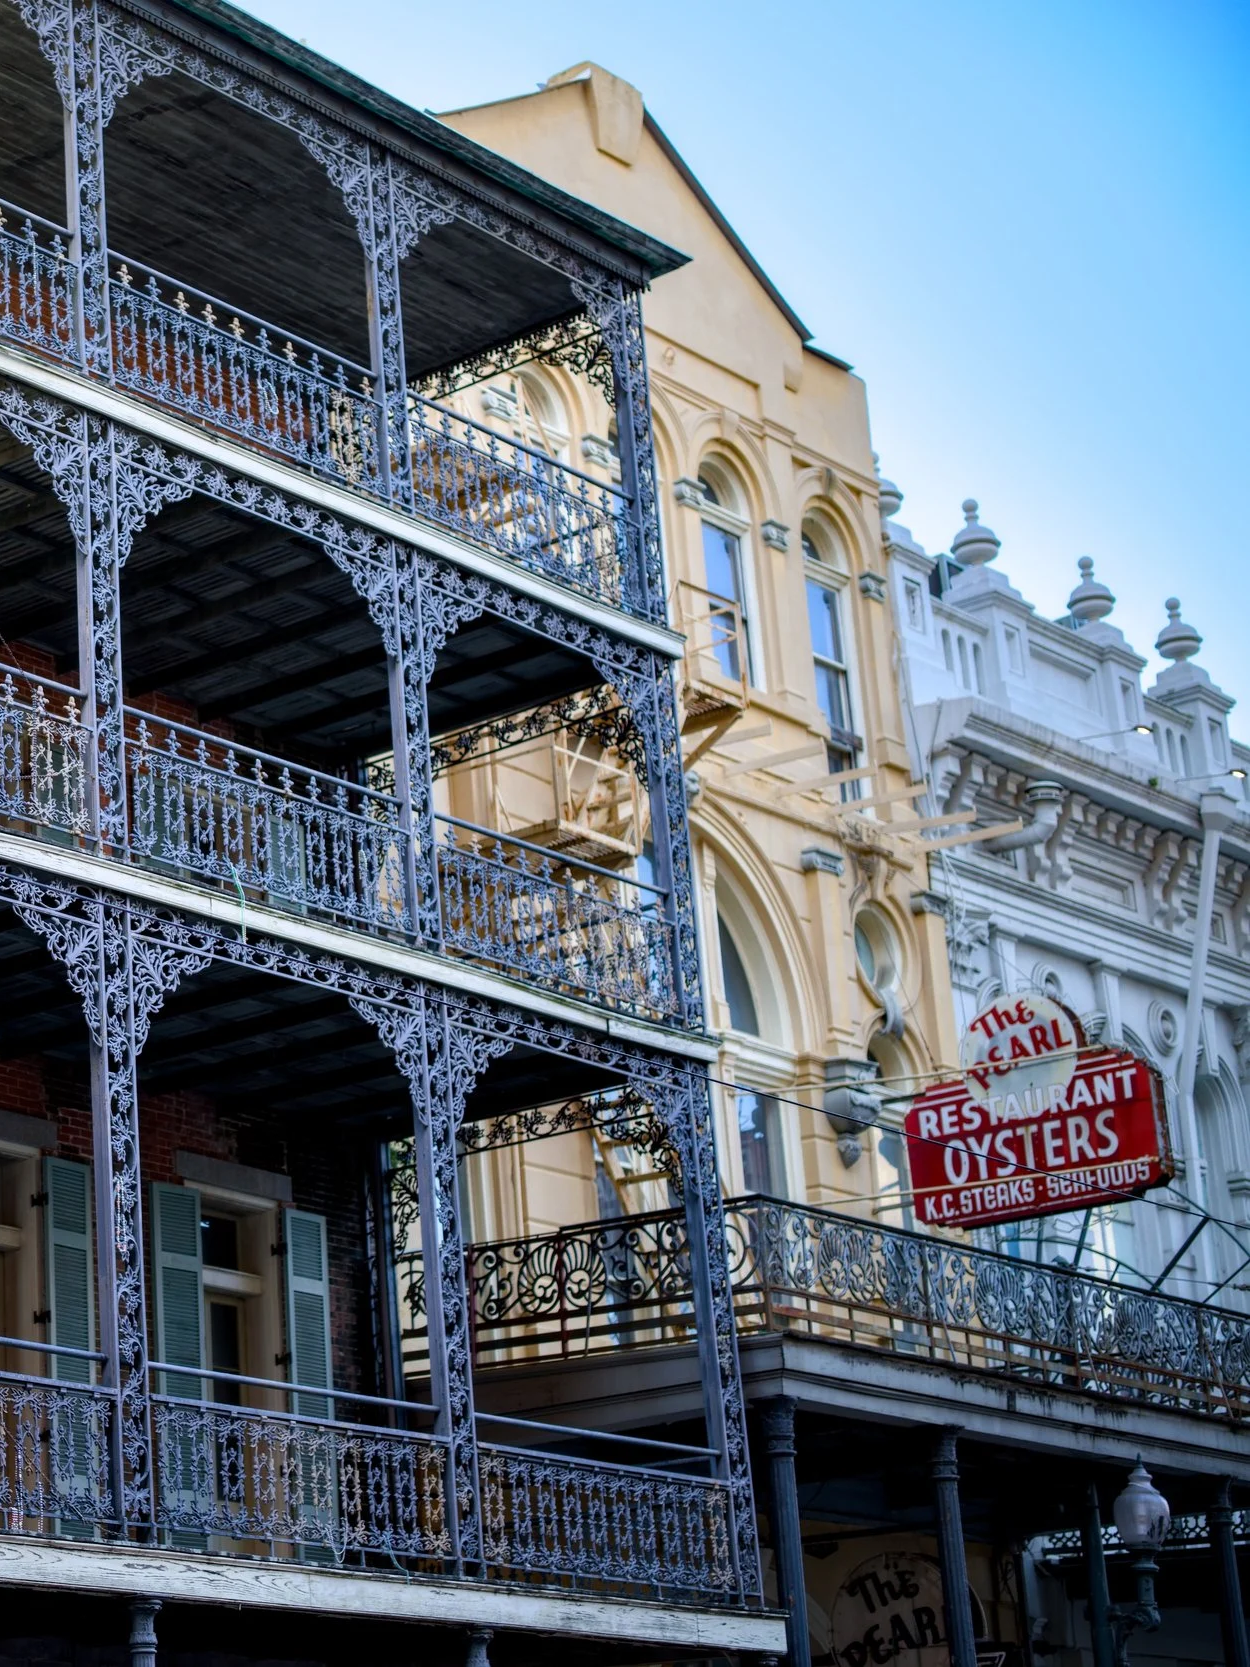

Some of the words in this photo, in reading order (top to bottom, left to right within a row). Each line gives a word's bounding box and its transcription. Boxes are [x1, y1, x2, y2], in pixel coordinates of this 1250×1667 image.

[967, 1018, 1072, 1091] PEARL
[917, 1068, 1137, 1140] RESTAURANT
[944, 1108, 1119, 1186] OYSTERS
